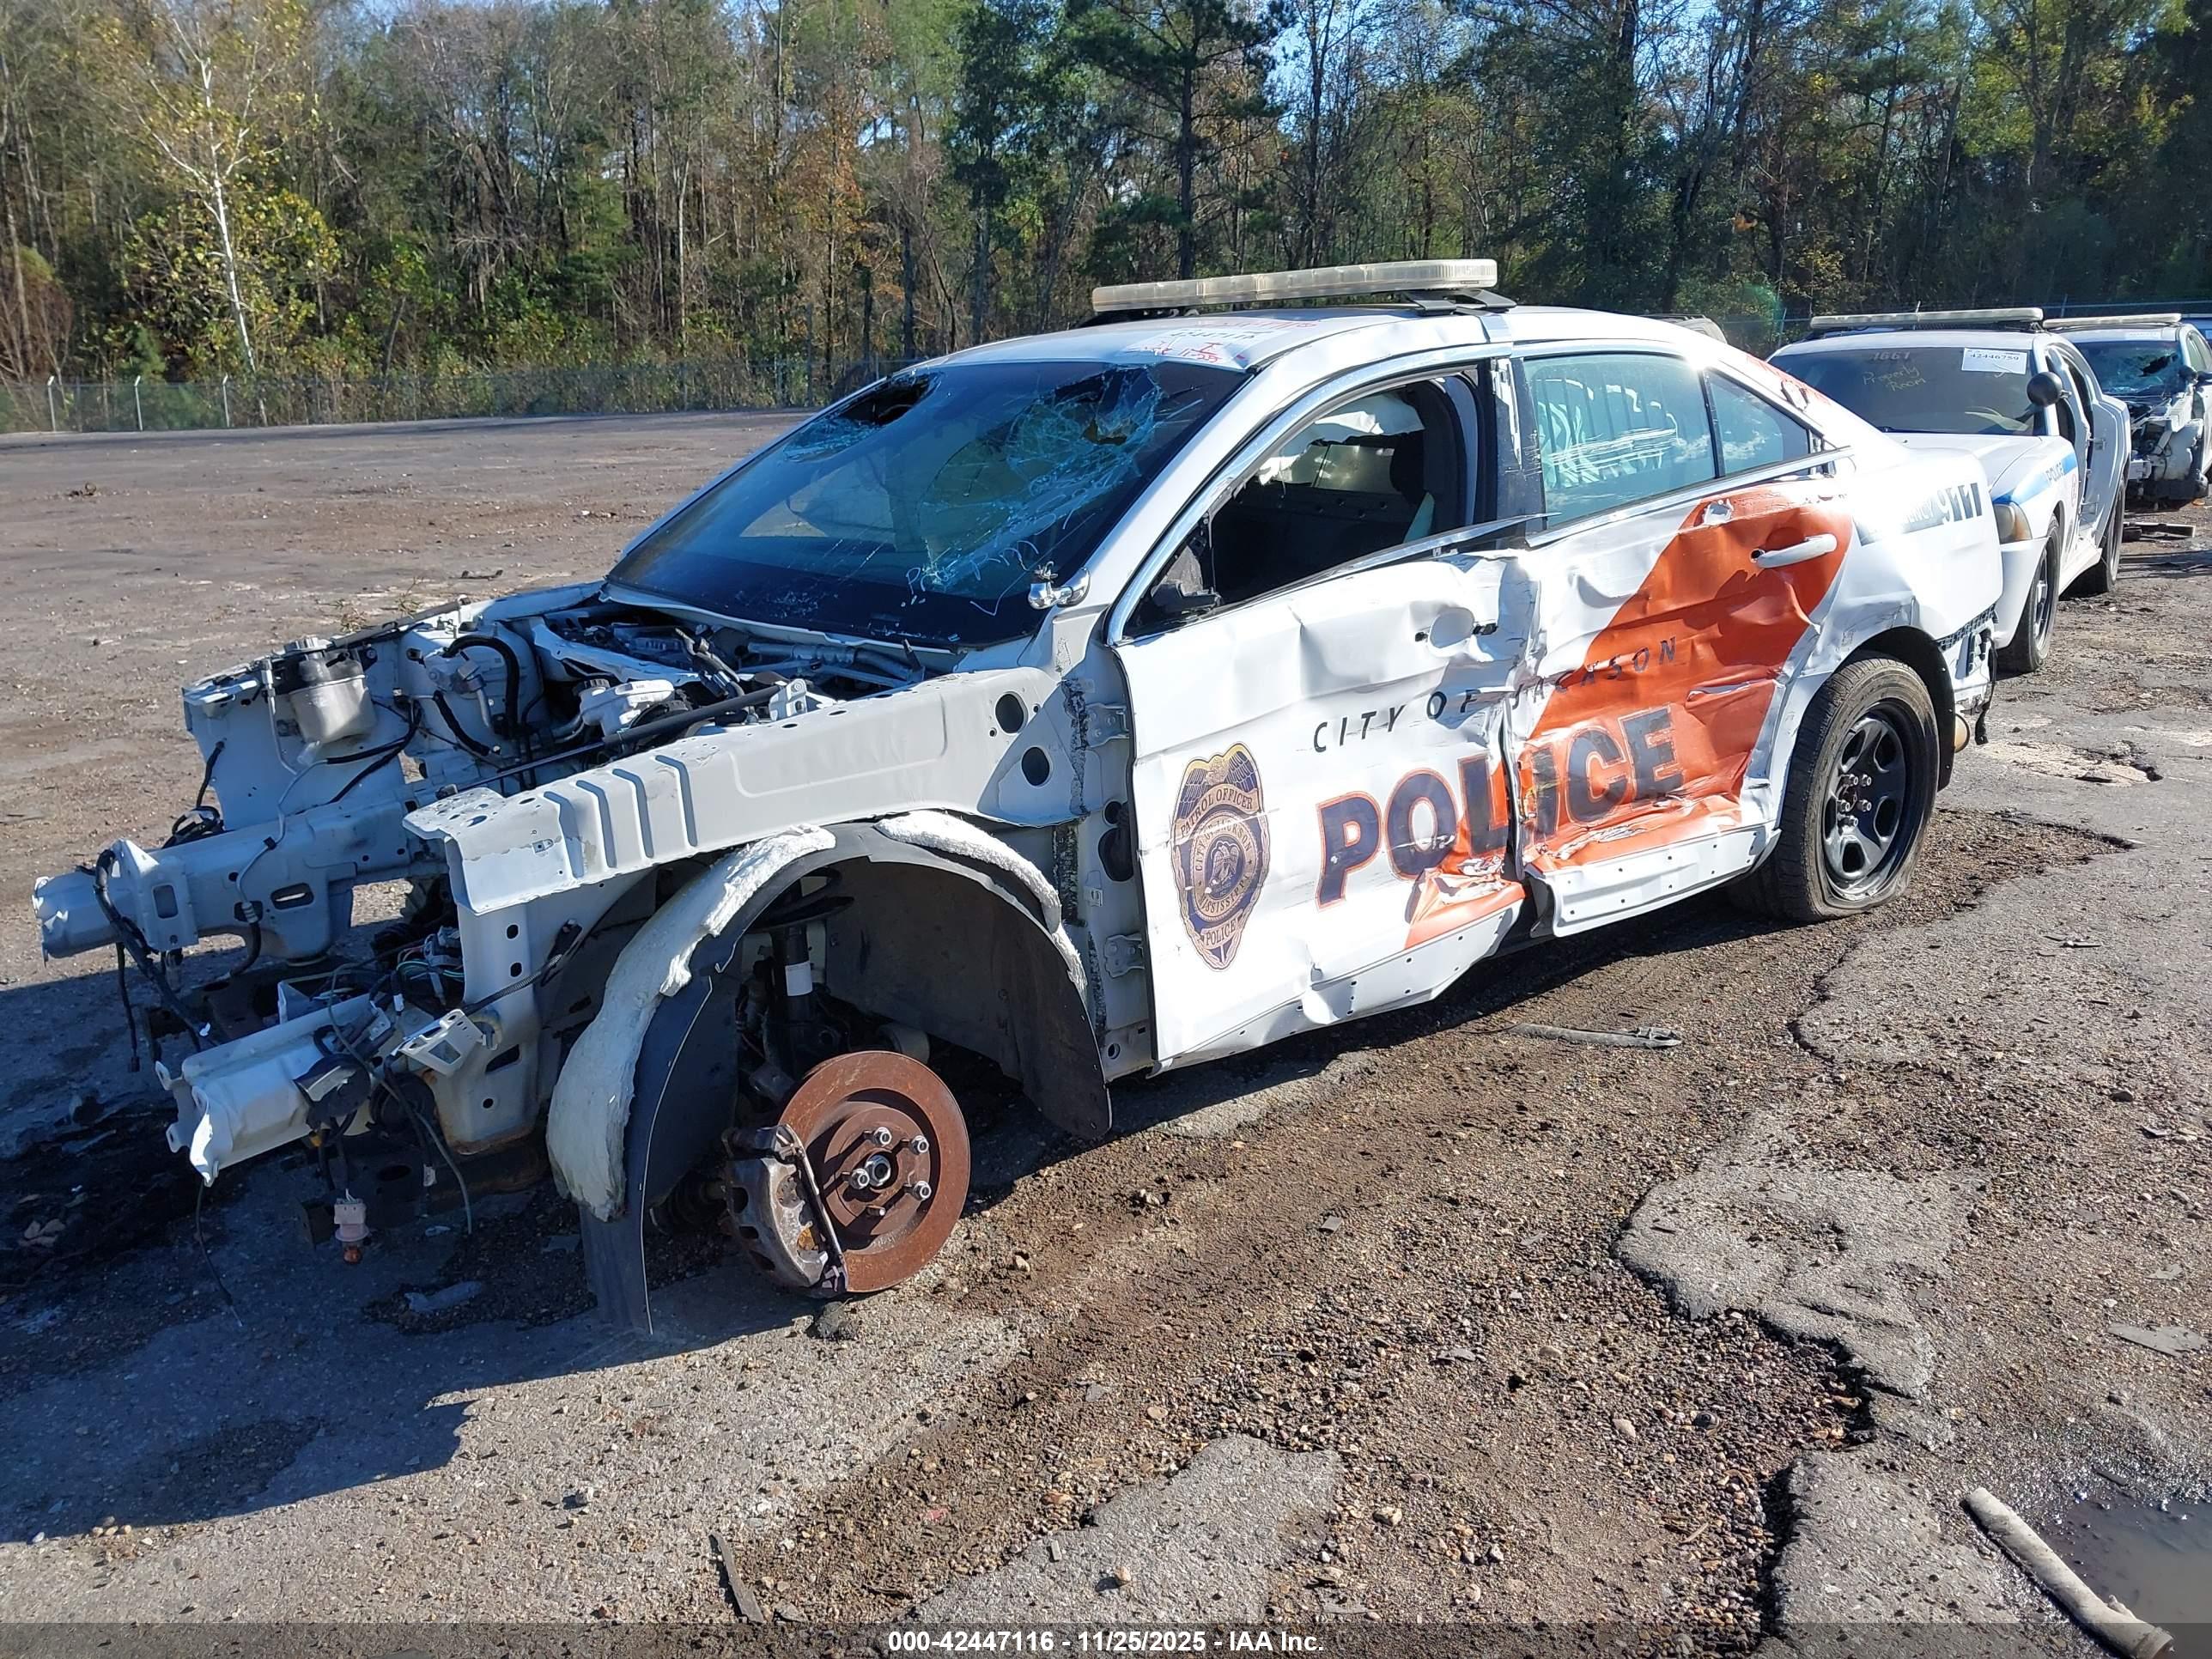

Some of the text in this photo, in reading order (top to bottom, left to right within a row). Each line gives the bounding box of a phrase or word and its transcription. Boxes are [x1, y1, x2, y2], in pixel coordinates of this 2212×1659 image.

[1313, 704, 1408, 753] CITY
[1426, 687, 1482, 720] OF
[1180, 787, 1253, 839] PATROL OFFICER
[1315, 705, 1685, 912] POLICE
[1194, 839, 1207, 872] CITY
[1198, 873, 1249, 914] MISSISSIPPI
[1206, 918, 1237, 946] POLICE
